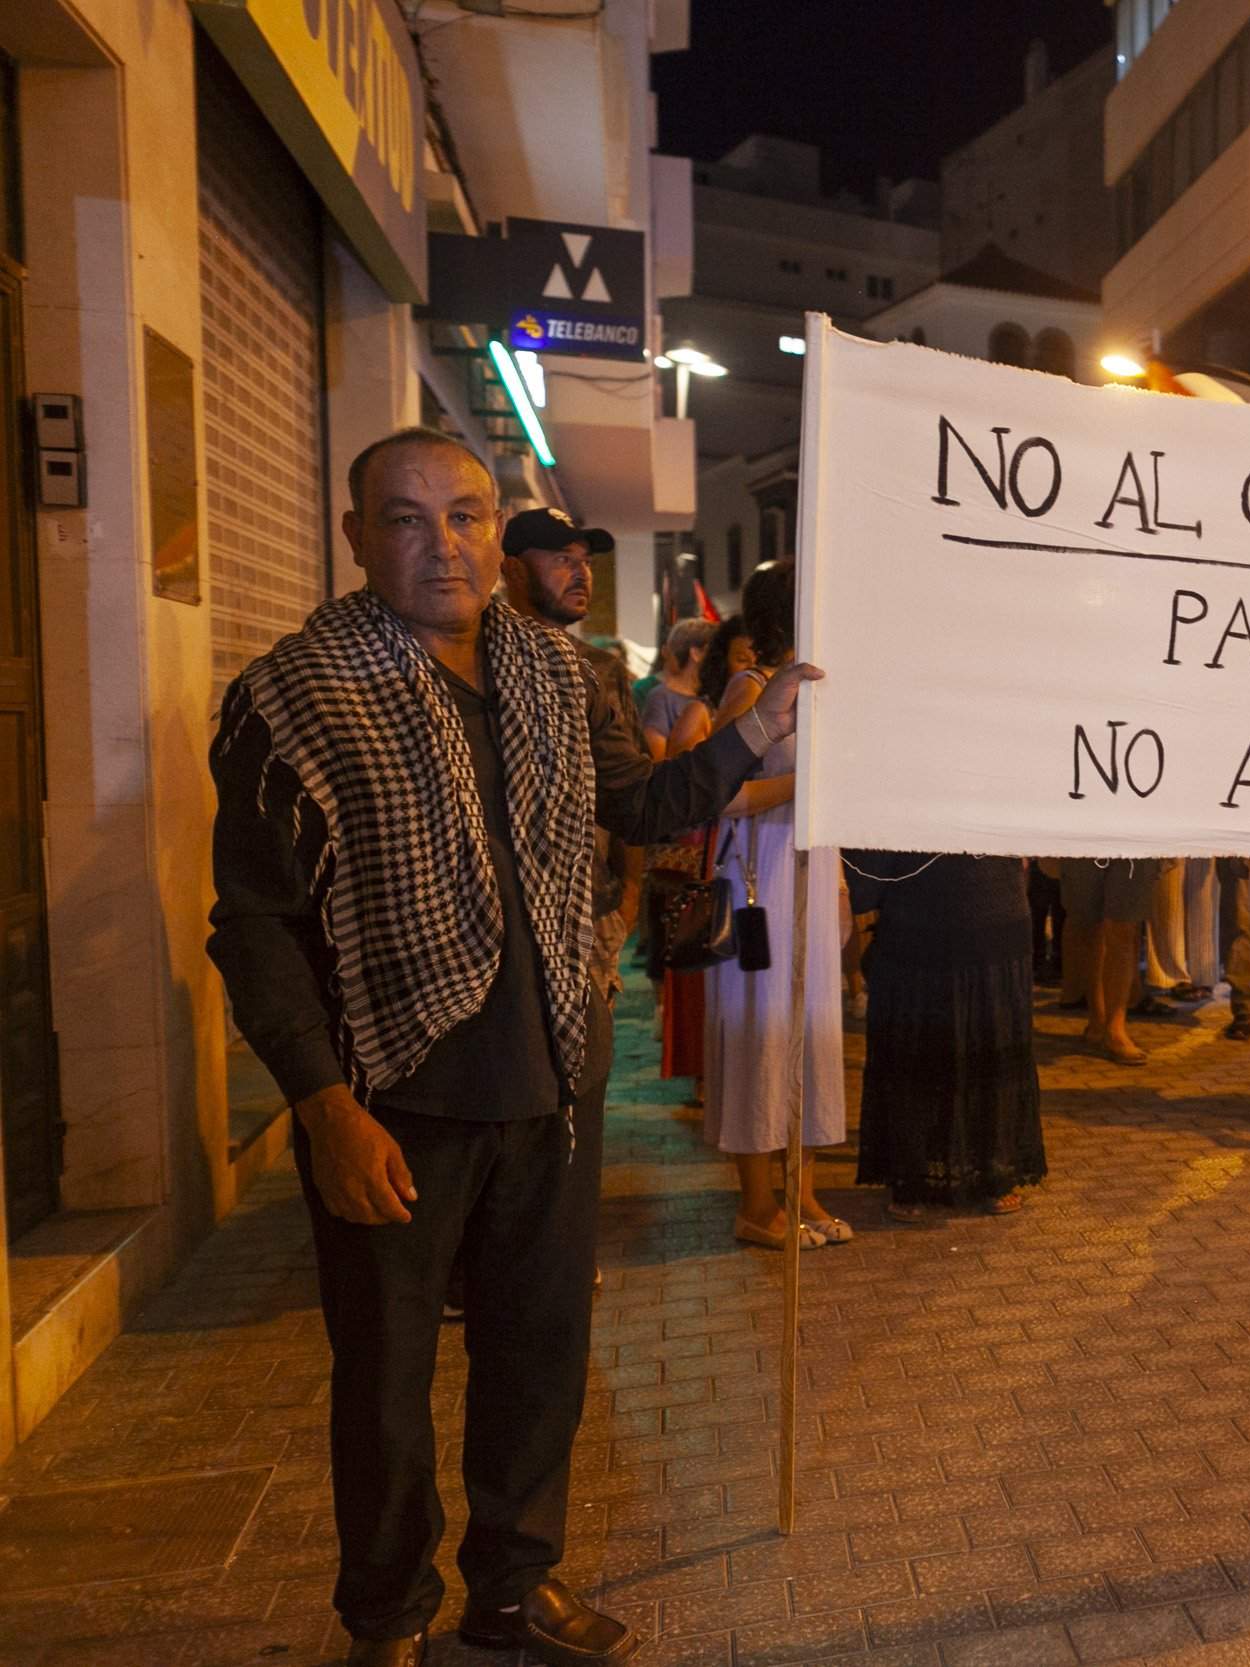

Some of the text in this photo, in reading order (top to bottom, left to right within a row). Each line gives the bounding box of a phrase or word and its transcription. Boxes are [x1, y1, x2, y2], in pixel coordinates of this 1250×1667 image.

[546, 318, 639, 346] TELEBANCO
[931, 415, 1063, 518] NO
[1094, 451, 1202, 538] AL
[1068, 720, 1164, 799] NO
